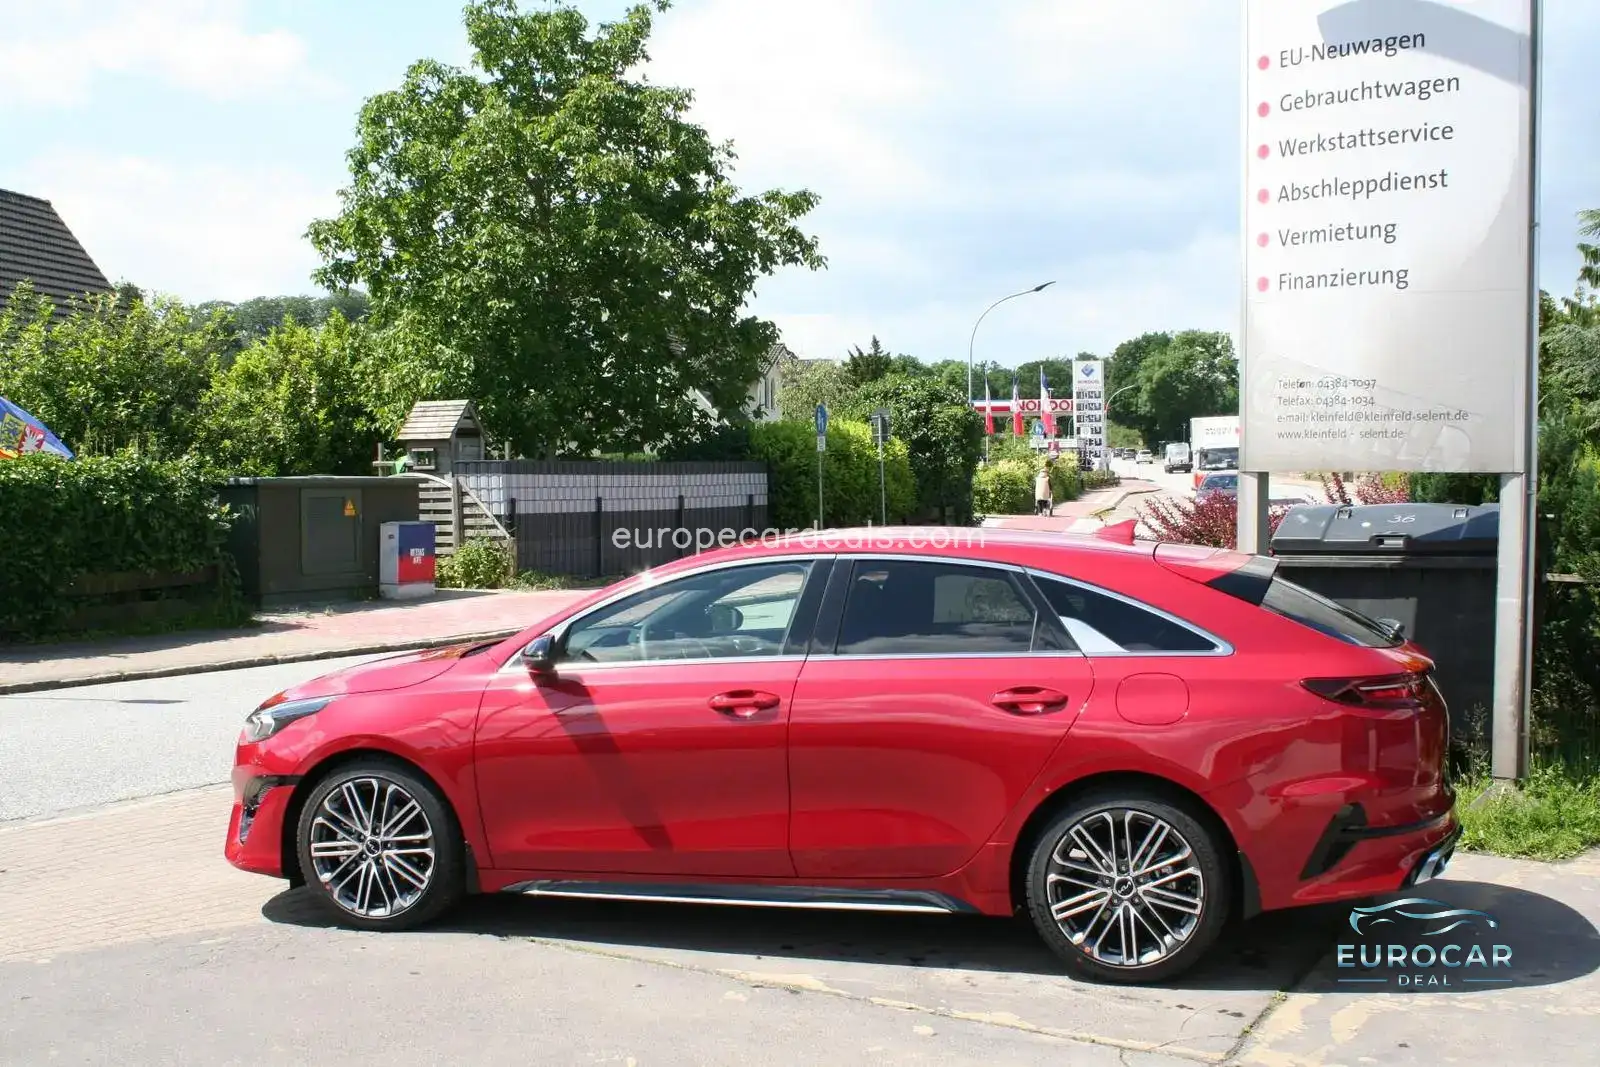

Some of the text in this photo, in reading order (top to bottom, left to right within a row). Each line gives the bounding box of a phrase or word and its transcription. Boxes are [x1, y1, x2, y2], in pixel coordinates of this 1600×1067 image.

[1279, 32, 1426, 69] EU-Neuwagen
[1279, 76, 1460, 113] Gebrauchtwagen
[1278, 123, 1454, 158] Werkstattservice
[1278, 168, 1449, 203] Abschleppdienst
[1278, 222, 1397, 247] Vermietung
[1278, 268, 1409, 291] Finanzierung
[1278, 395, 1314, 406] Telefax:
[1387, 514, 1416, 524] 36
